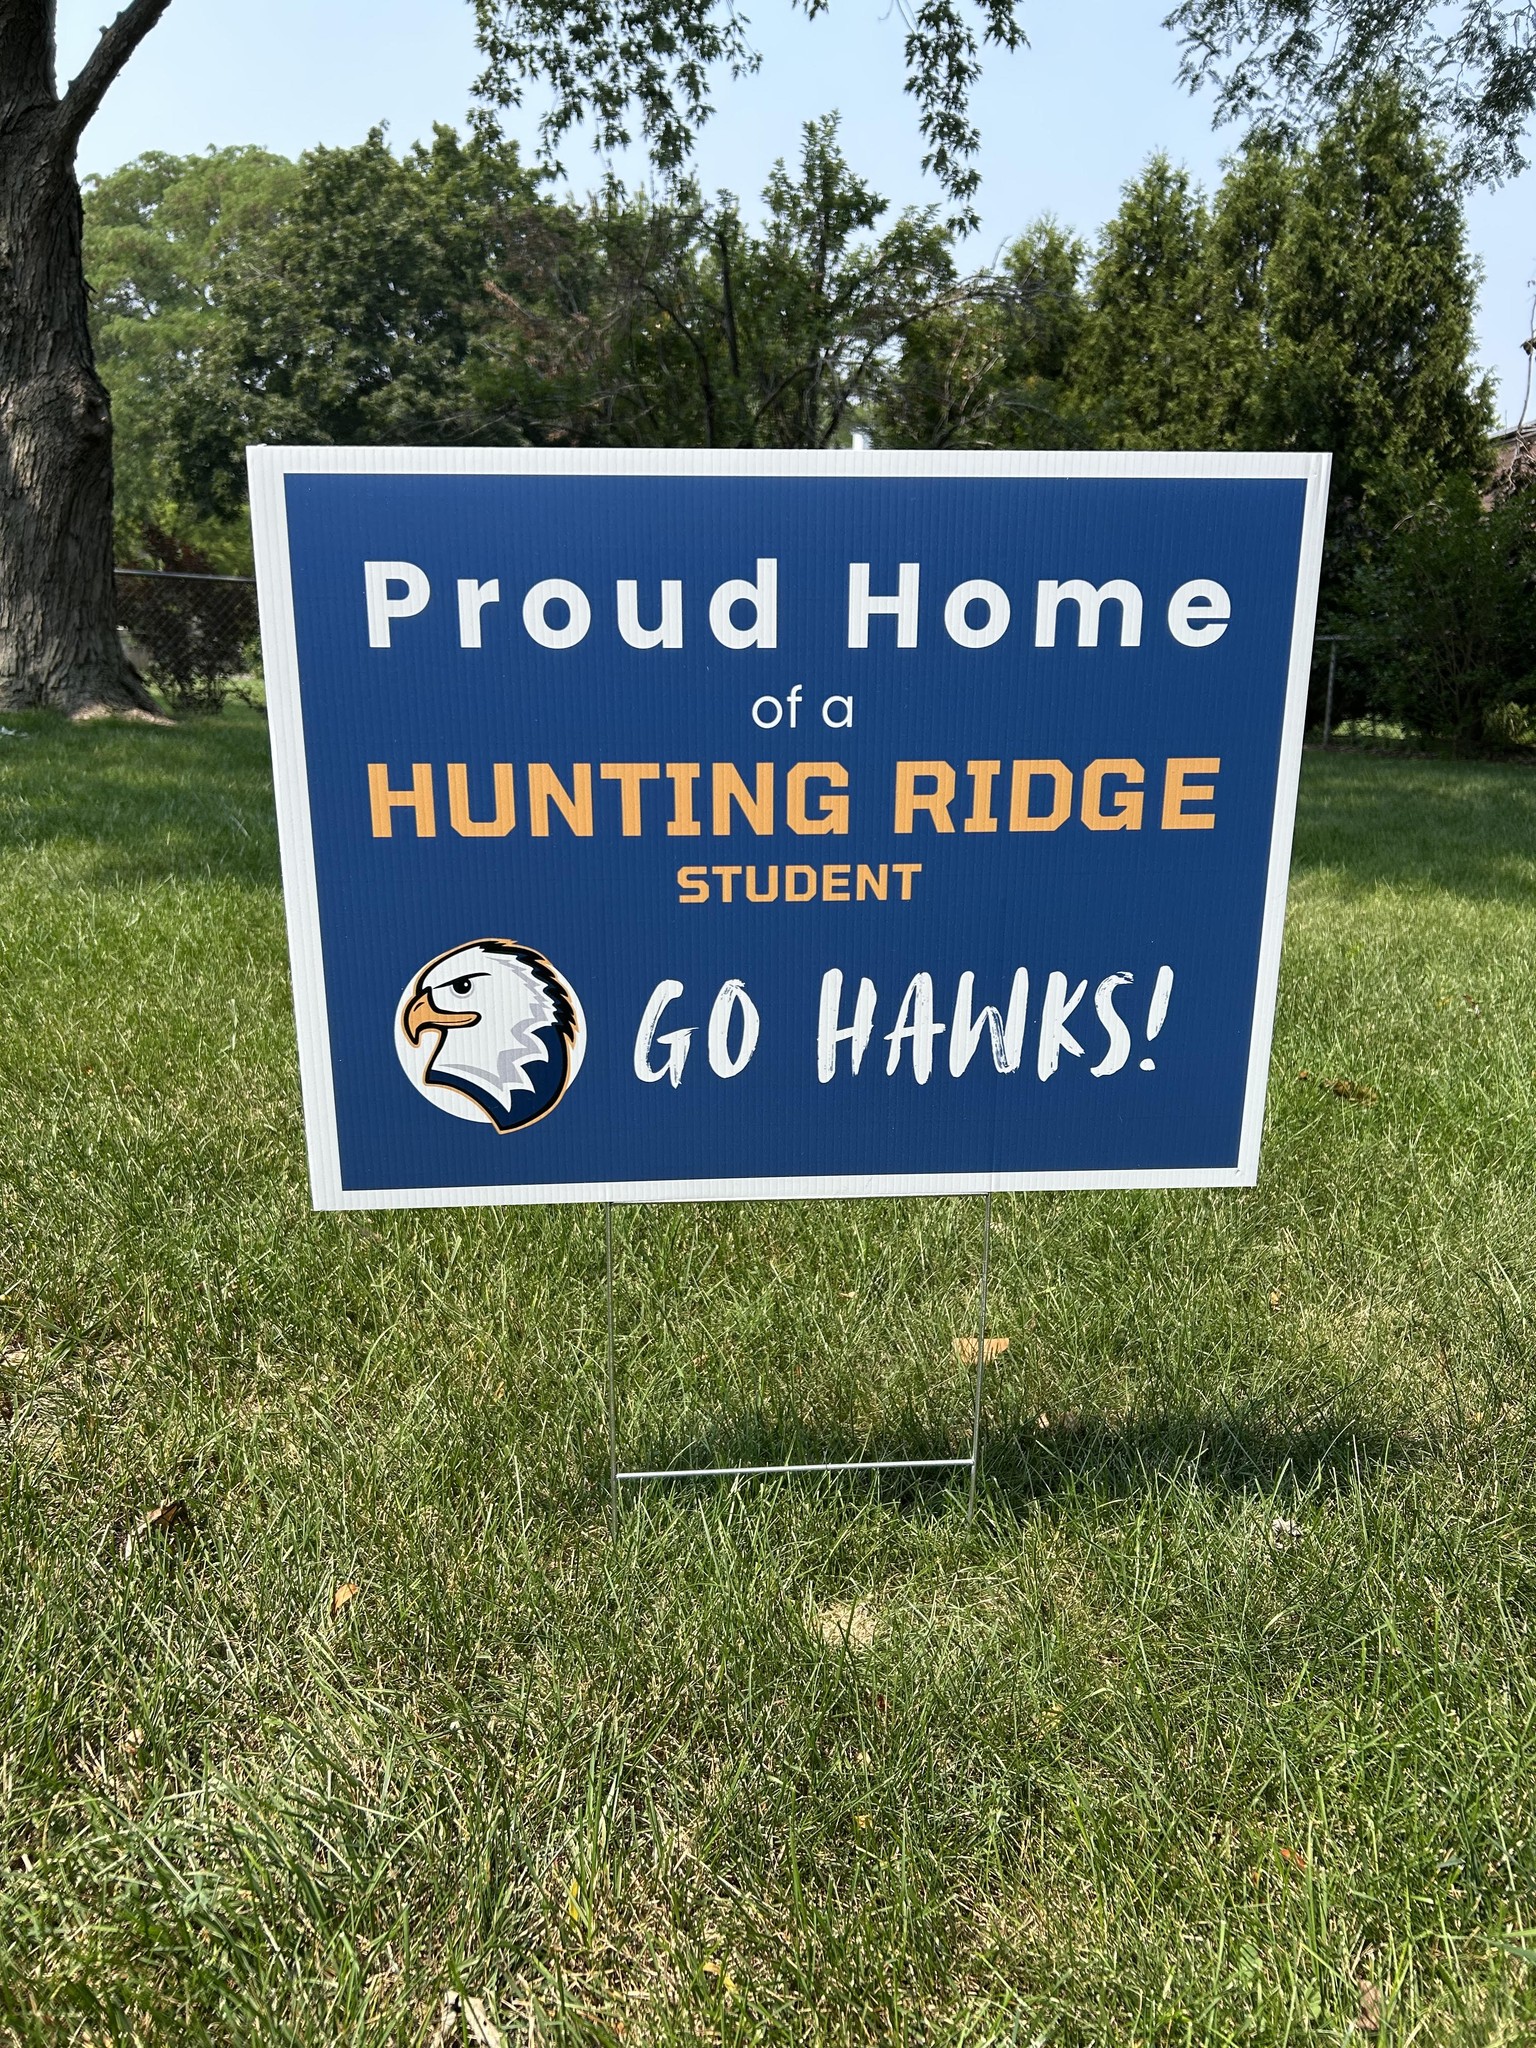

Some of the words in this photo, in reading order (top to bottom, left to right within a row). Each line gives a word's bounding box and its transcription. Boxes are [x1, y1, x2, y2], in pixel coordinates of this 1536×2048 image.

[364, 557, 778, 650] Proud
[848, 562, 1231, 649] Home
[751, 684, 803, 729] of
[822, 695, 853, 729] a
[367, 761, 850, 838] HUNTING
[893, 757, 1221, 834] RIDGE
[677, 863, 923, 904] STUDENT
[633, 978, 760, 1088] GO
[816, 965, 1175, 1086] HAWKS!
